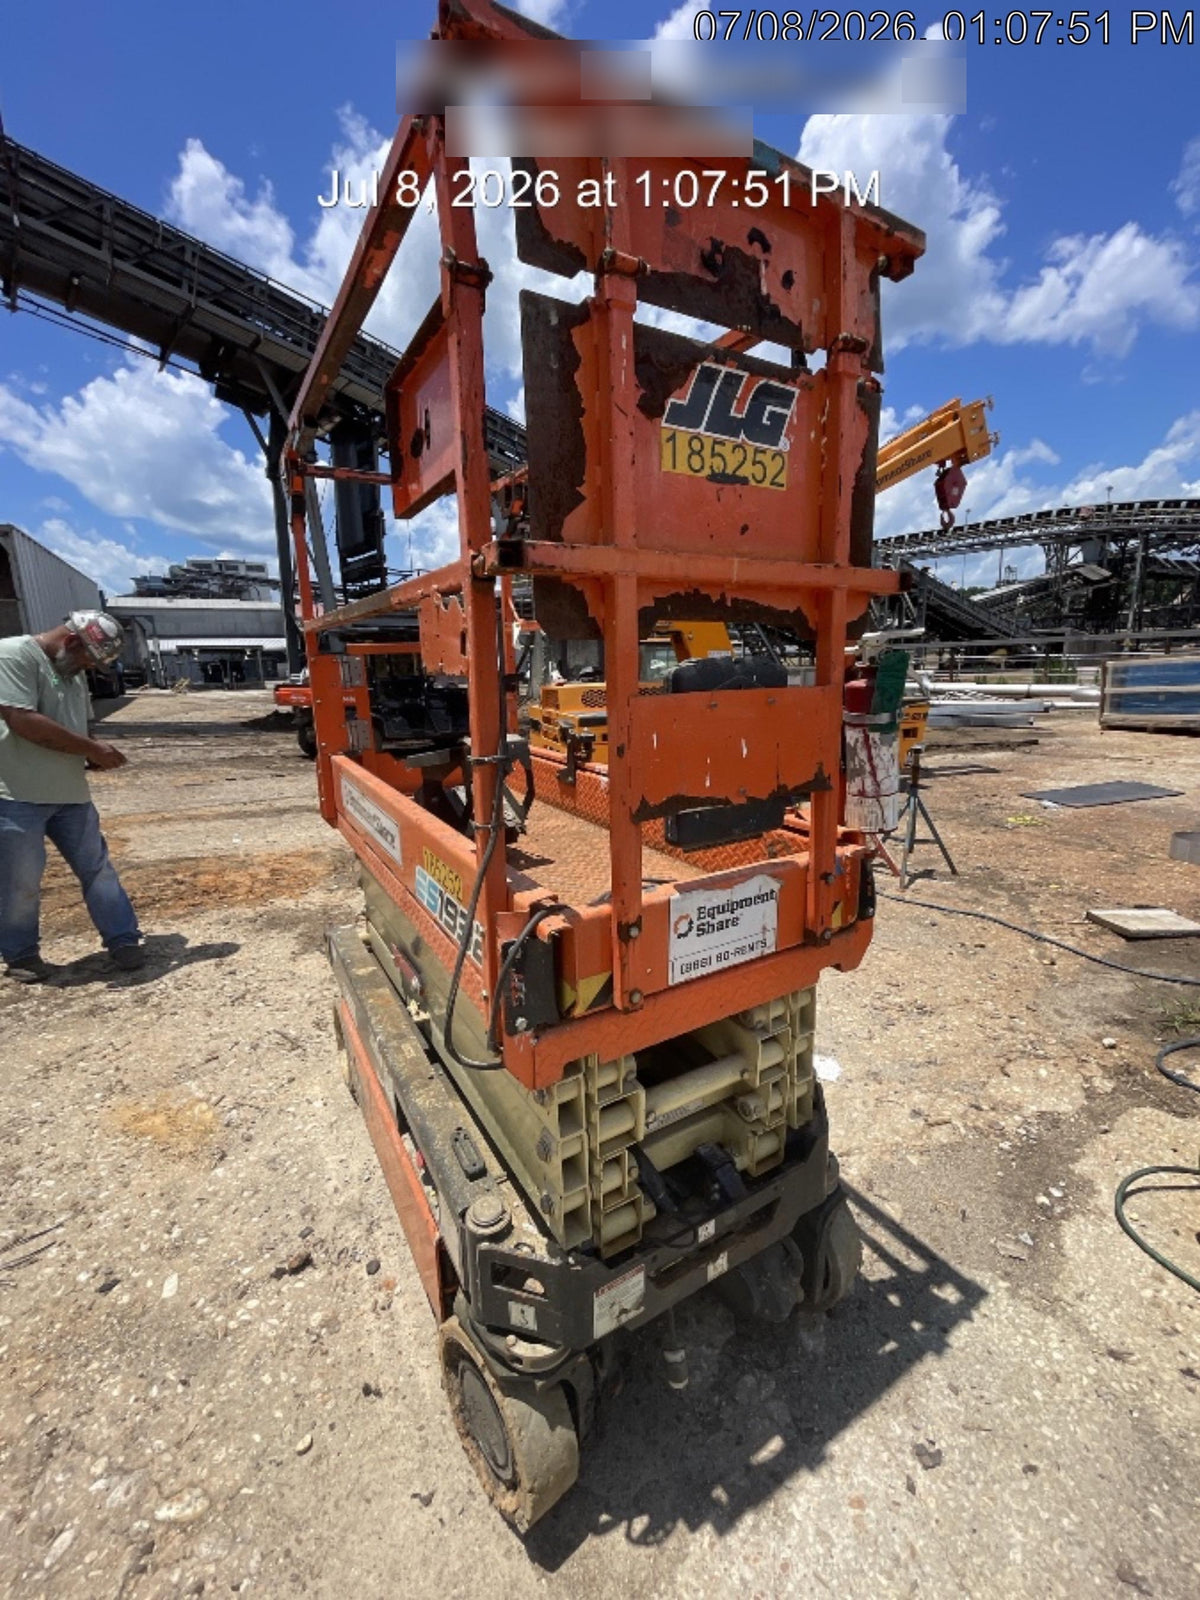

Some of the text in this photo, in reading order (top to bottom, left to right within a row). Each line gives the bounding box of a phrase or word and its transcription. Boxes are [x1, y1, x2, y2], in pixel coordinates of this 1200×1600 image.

[661, 361, 800, 451] JLG
[665, 431, 786, 488] 185252
[696, 888, 777, 921] Equipment
[696, 916, 740, 937] Share
